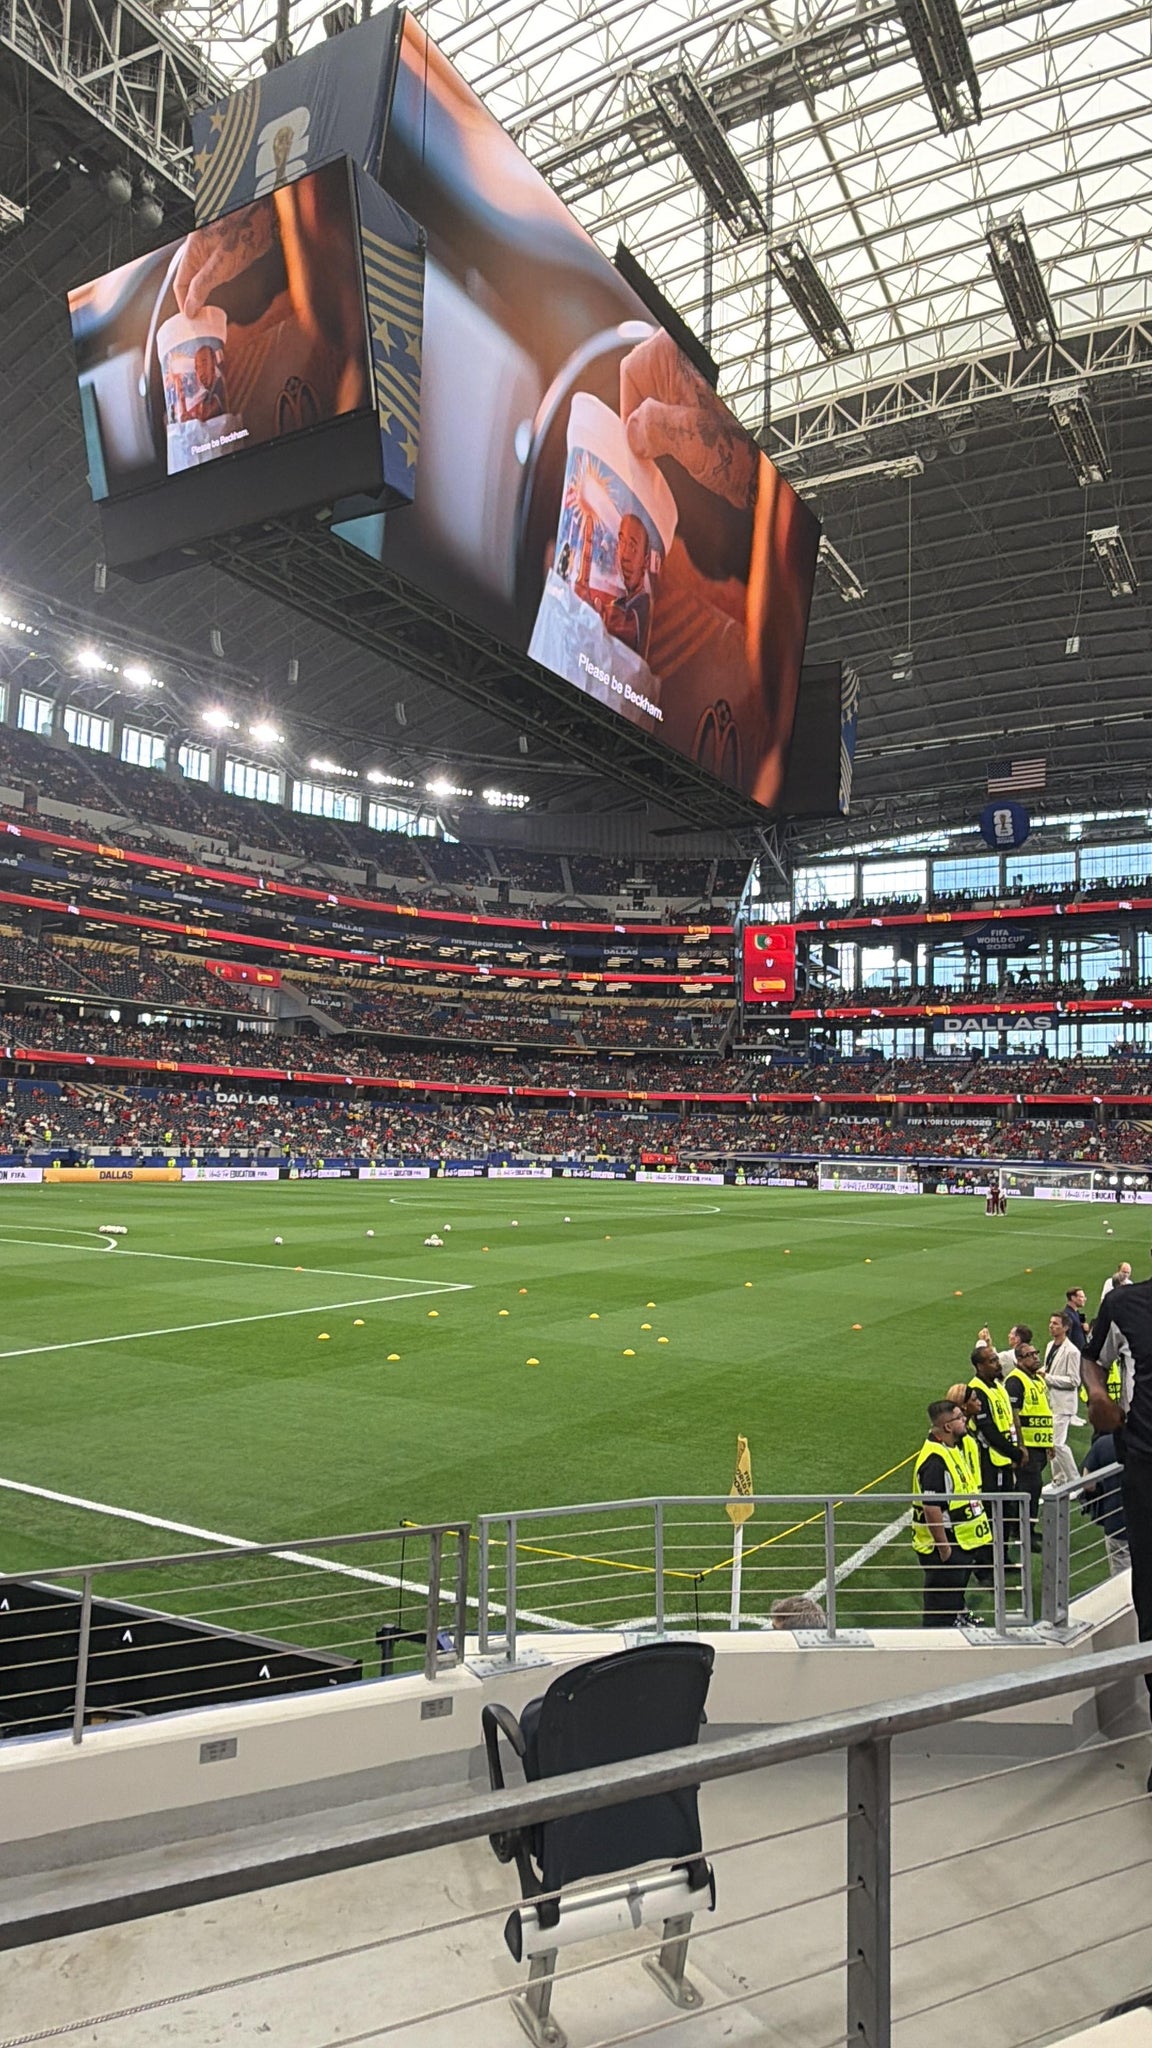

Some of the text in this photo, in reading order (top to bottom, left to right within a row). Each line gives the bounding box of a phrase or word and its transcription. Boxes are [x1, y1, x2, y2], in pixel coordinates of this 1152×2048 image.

[578, 652, 664, 722] Please be Beckham.
[331, 922, 365, 933] DALLAS
[991, 929, 1009, 937] FIFA
[976, 935, 1025, 944] WORLD CUP
[944, 1016, 1052, 1031] DALLAS
[216, 1092, 279, 1106] DALLAS
[829, 1116, 880, 1125] DALLAS
[99, 1170, 133, 1179] DALLAS
[1091, 1191, 1126, 1200] EDUCATN
[1029, 1417, 1053, 1426] SECU
